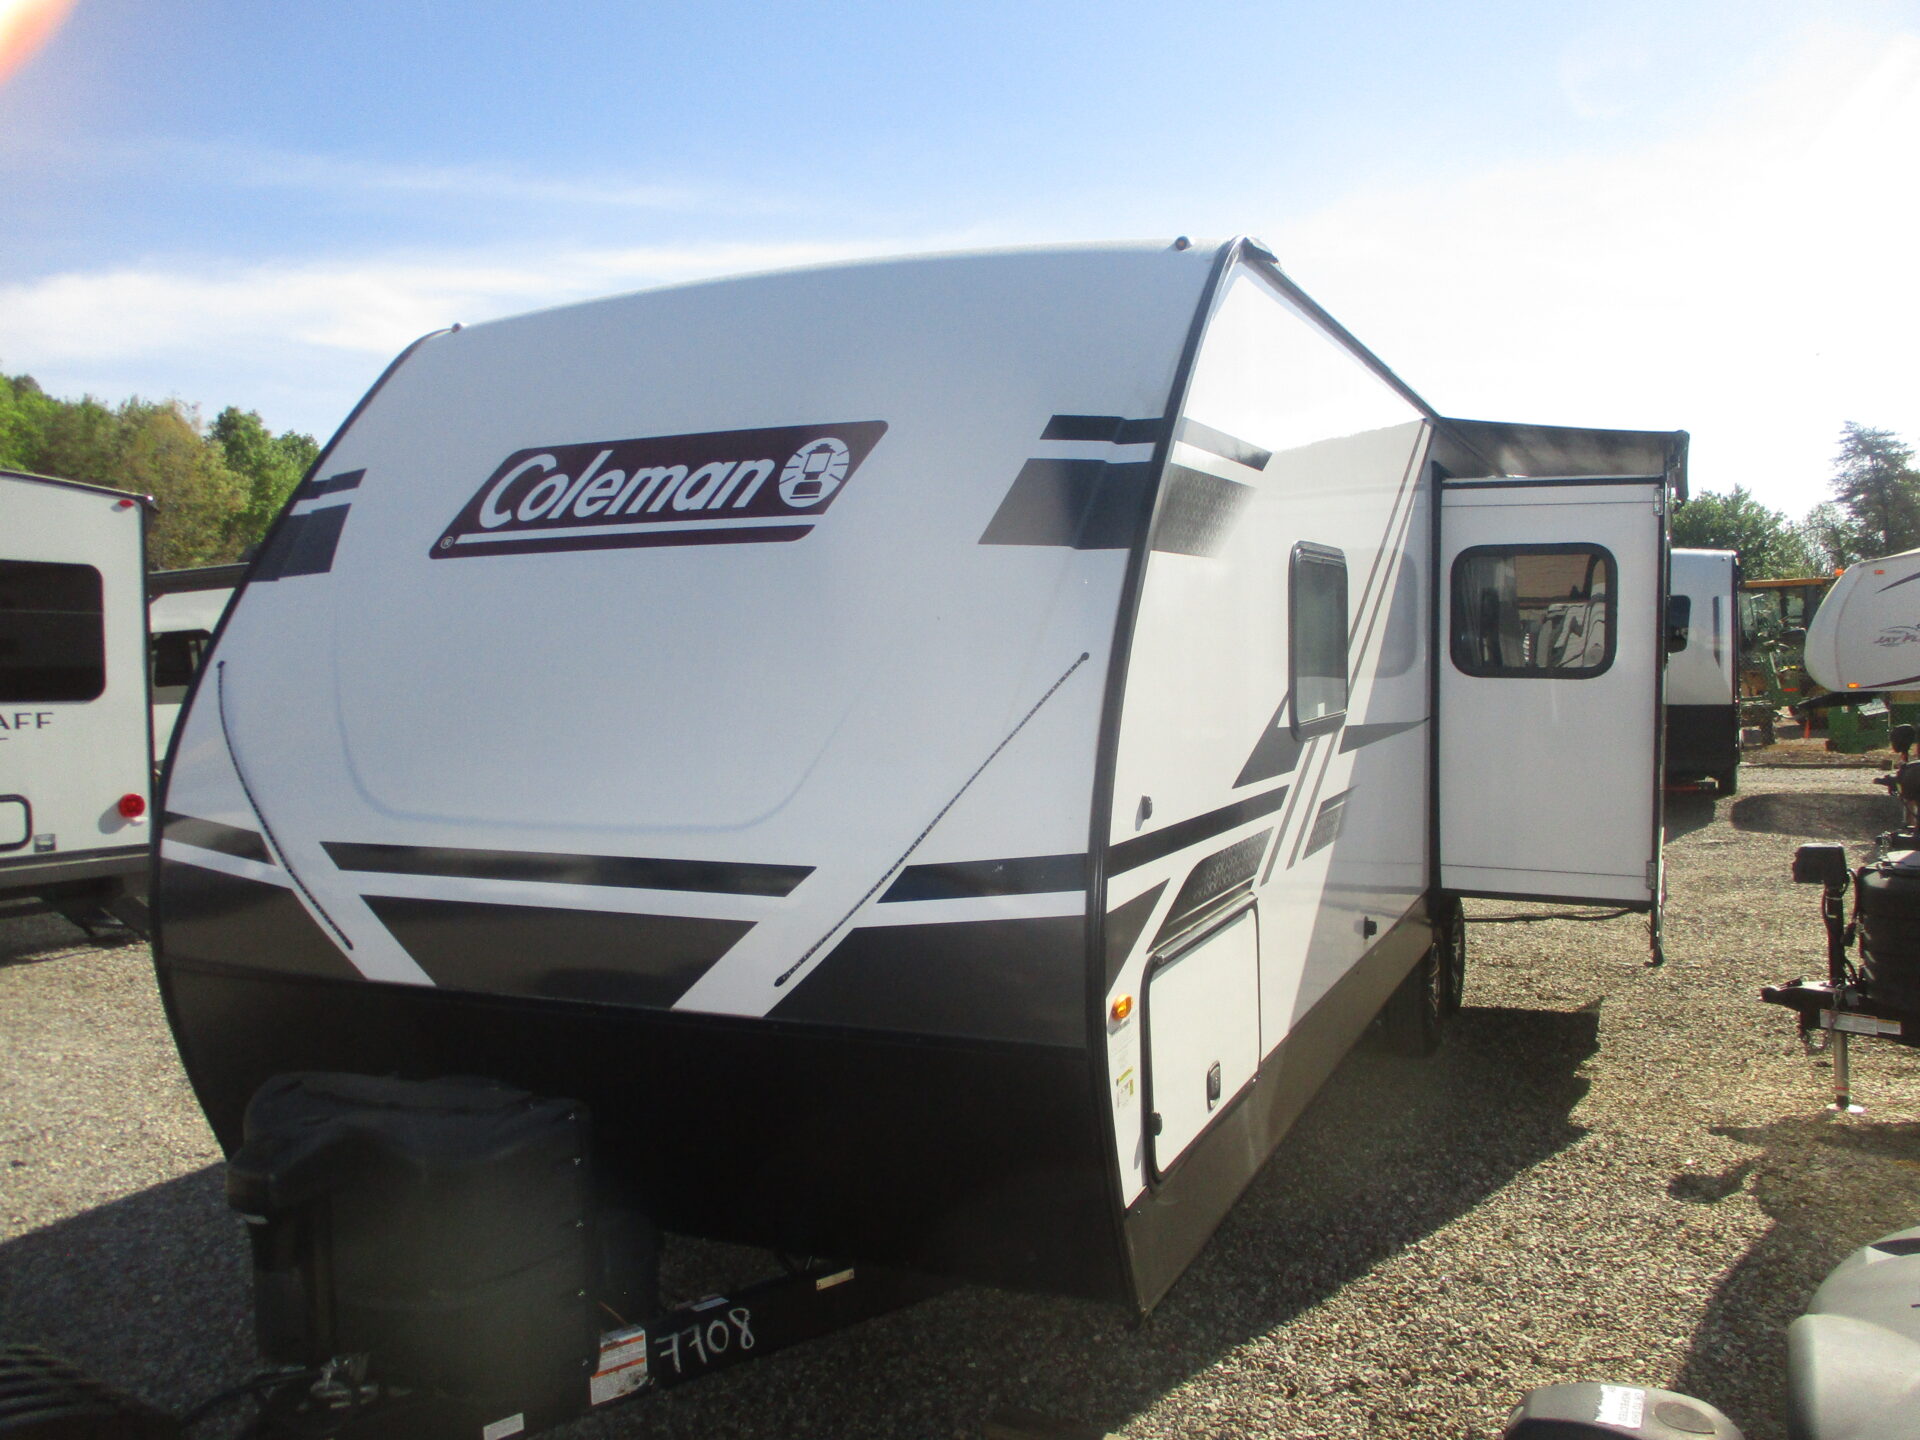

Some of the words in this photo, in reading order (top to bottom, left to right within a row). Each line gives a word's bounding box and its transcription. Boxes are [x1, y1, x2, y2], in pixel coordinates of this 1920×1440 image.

[479, 449, 775, 529] Coleman
[655, 1307, 755, 1373] 7708
[1617, 1391, 1631, 1421] INSPECTED
